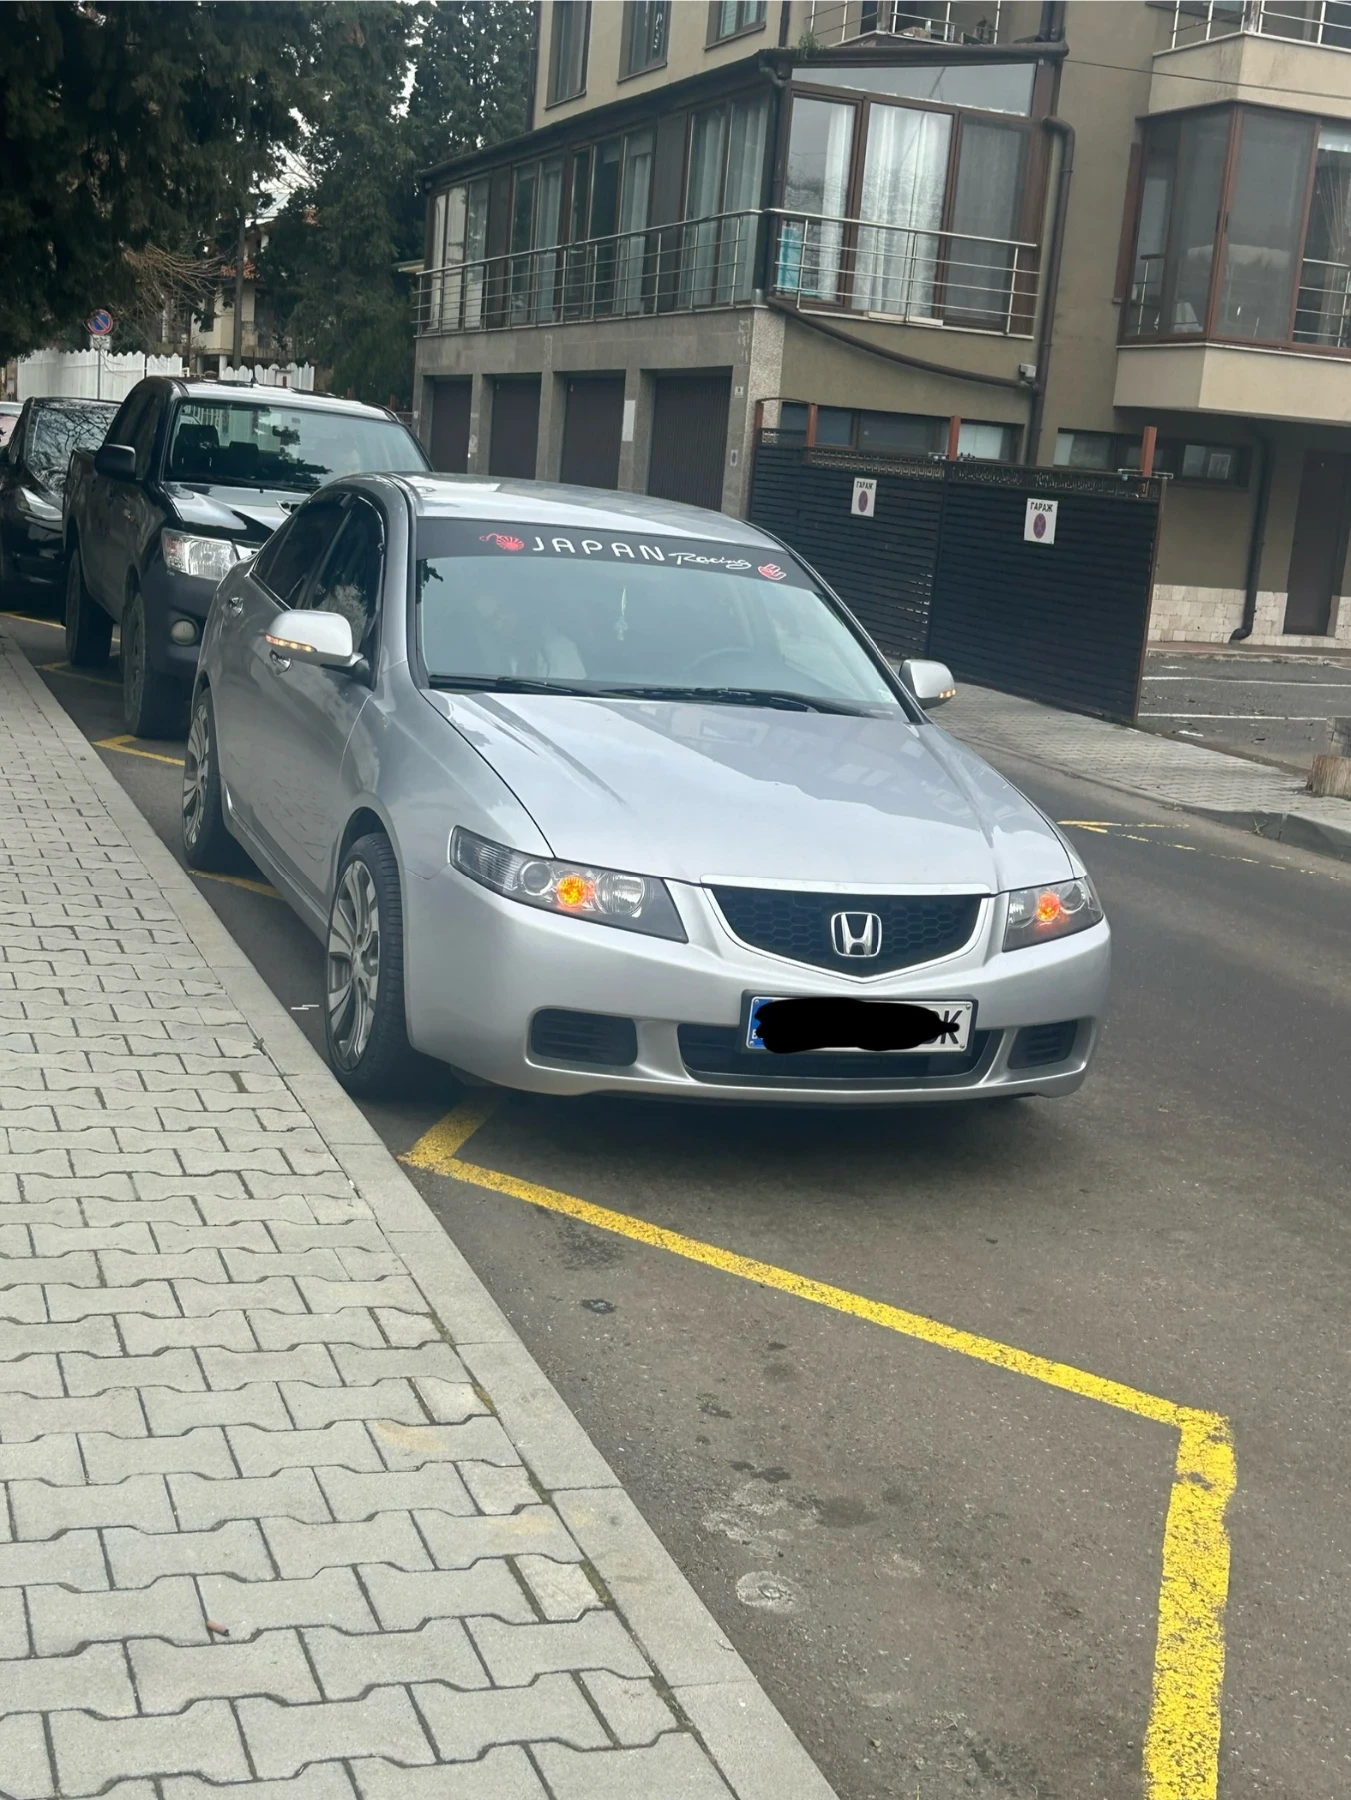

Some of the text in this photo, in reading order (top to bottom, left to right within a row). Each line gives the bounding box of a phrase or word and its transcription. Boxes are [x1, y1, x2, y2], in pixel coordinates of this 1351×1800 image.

[1030, 501, 1053, 512] ГАРАЖ
[532, 536, 752, 570] JAPAN Racing
